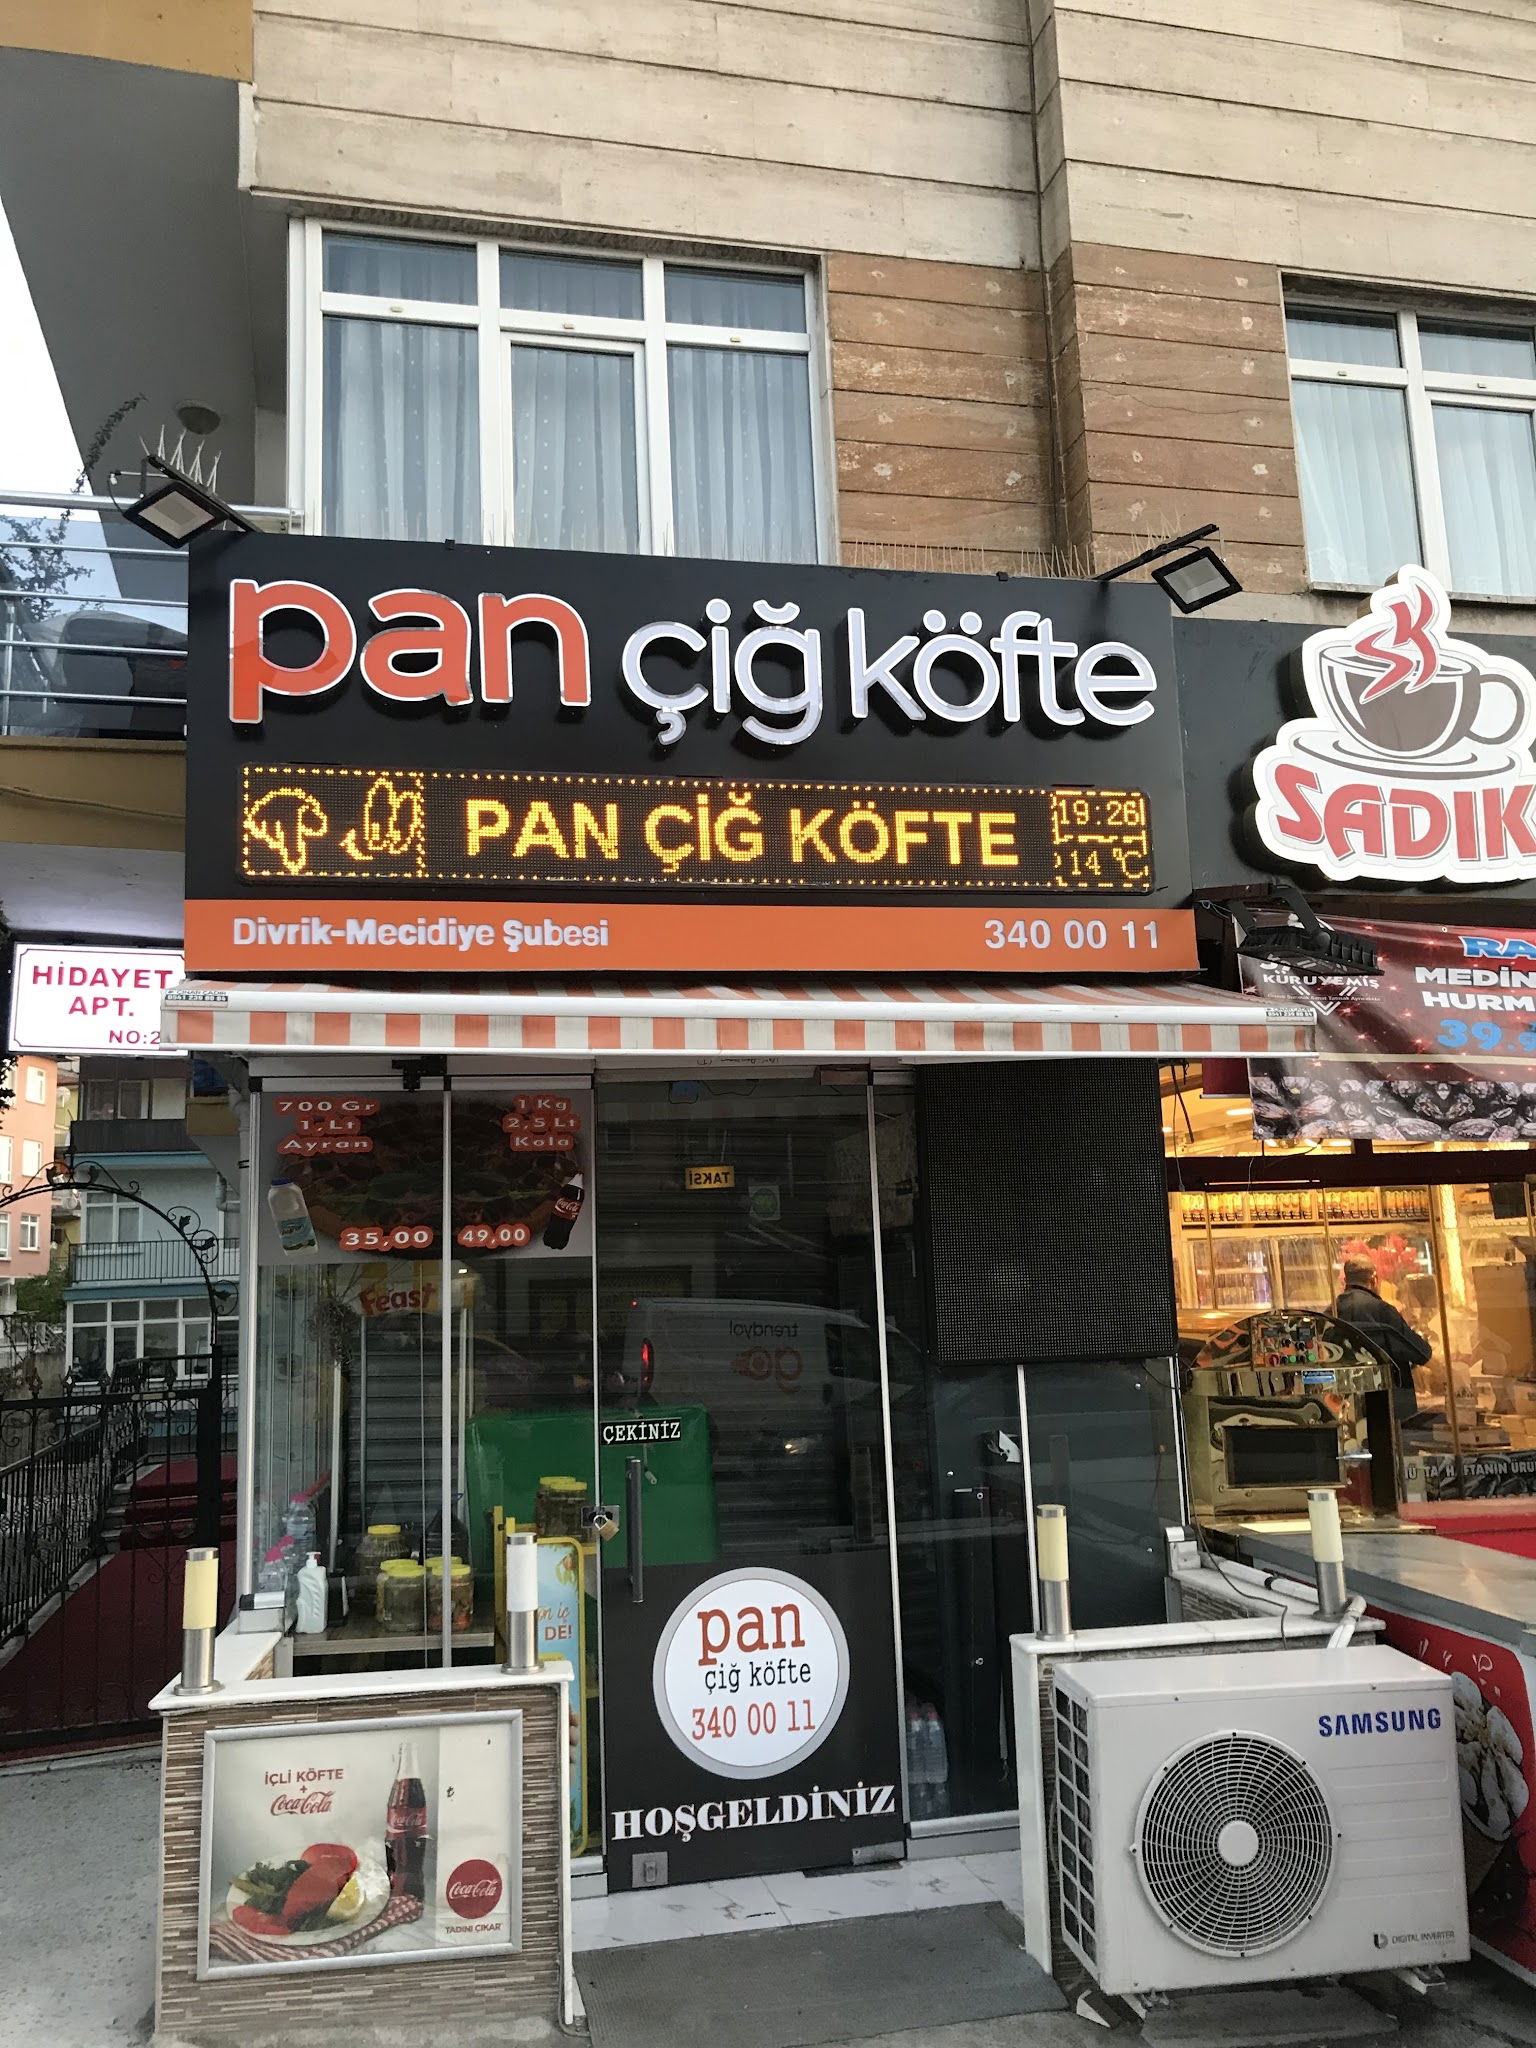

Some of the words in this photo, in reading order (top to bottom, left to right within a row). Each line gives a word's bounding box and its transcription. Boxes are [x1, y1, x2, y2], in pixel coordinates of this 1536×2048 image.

[229, 578, 592, 724] pan
[621, 597, 824, 746] çiğ
[847, 607, 1158, 727] köfte
[1059, 799, 1140, 826] 19:26
[1275, 763, 1536, 861] SADIK
[465, 798, 620, 861] PAN
[644, 792, 764, 874] ÇİĞ
[790, 802, 1020, 868] KÖFTE
[1071, 849, 1101, 876] 14
[232, 917, 496, 951] Divrik-Mecidiye
[502, 917, 610, 952] Şubesi
[984, 919, 1051, 950] 340
[1063, 919, 1107, 949] 00
[1121, 920, 1158, 949] 11
[32, 960, 174, 989] HİDAYET
[69, 995, 135, 1017] APT.
[1421, 991, 1536, 1012] HURM
[279, 1101, 333, 1112] 700
[341, 1100, 375, 1111] Gr
[537, 1099, 567, 1111] Kg
[283, 1139, 369, 1151] Ayran
[515, 1136, 569, 1147] Kola
[345, 1230, 429, 1247] 35,00
[462, 1228, 525, 1244] 49,00
[360, 1283, 436, 1316] Feast
[602, 1420, 681, 1445] ÇEKİNİZ
[697, 1602, 806, 1666] pan
[704, 1662, 741, 1695] çiğ
[749, 1658, 812, 1687] köfte
[691, 1704, 737, 1740] 340
[747, 1701, 777, 1736] 00
[787, 1699, 816, 1732] 11
[1318, 1707, 1442, 1738] SAMSUNG
[264, 1768, 292, 1787] İÇLİ
[296, 1767, 345, 1783] KÖFTE
[611, 1781, 896, 1843] HOŞGELDİNİZ
